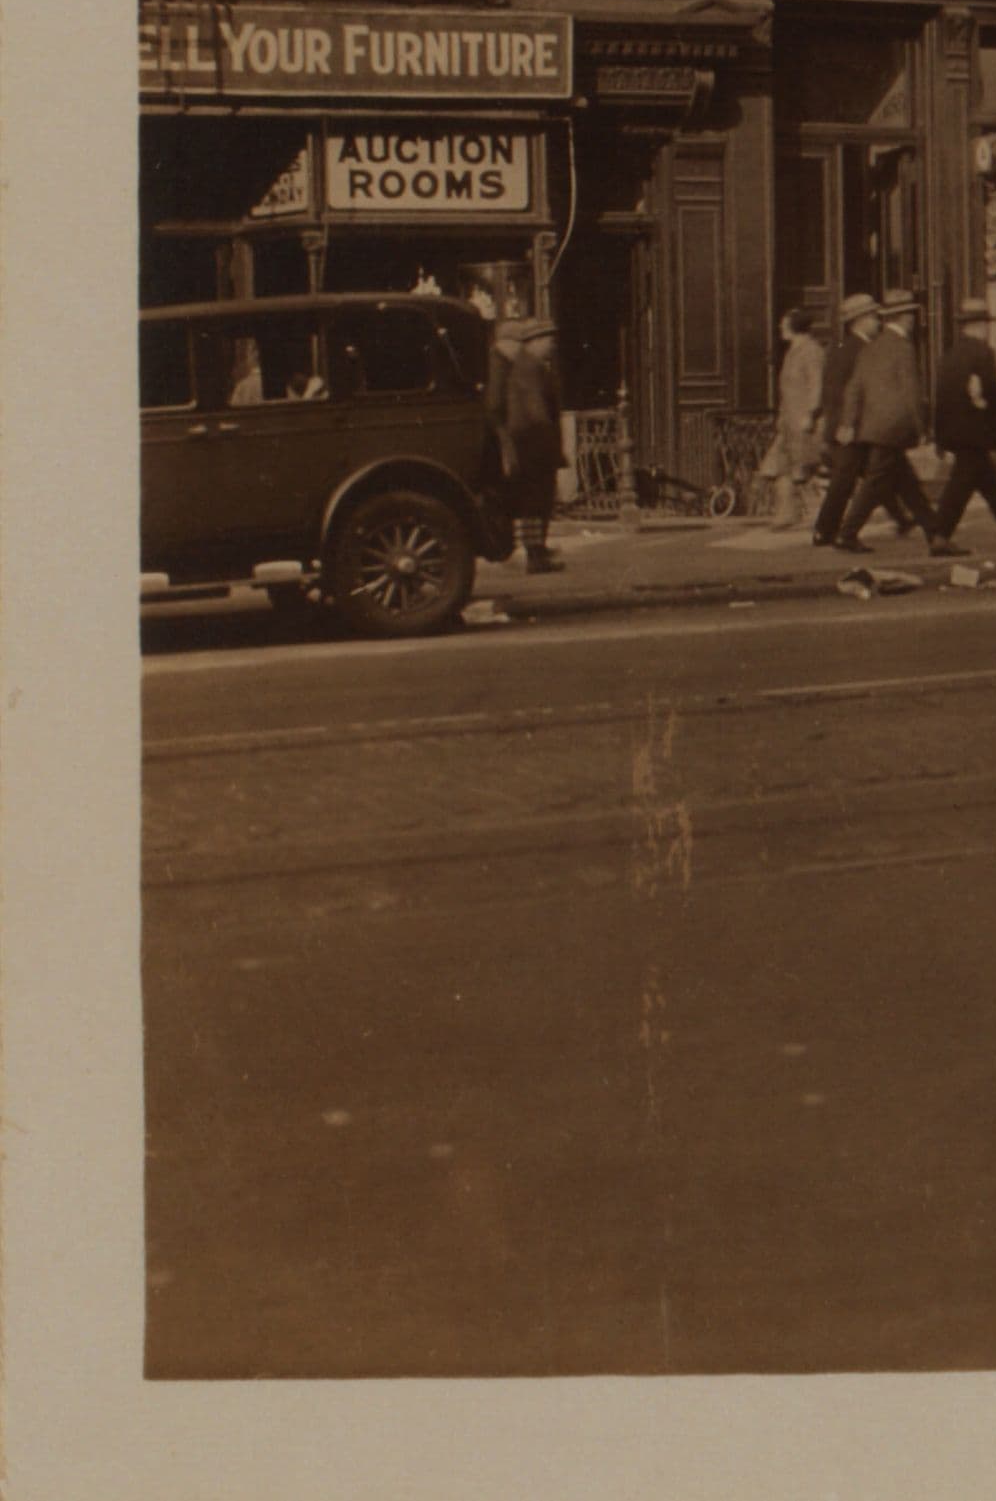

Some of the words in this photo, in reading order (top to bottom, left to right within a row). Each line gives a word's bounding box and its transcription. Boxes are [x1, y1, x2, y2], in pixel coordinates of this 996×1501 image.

[344, 24, 559, 77] FURNITURE
[338, 136, 513, 164] AUCTION
[349, 170, 506, 199] ROOMS
